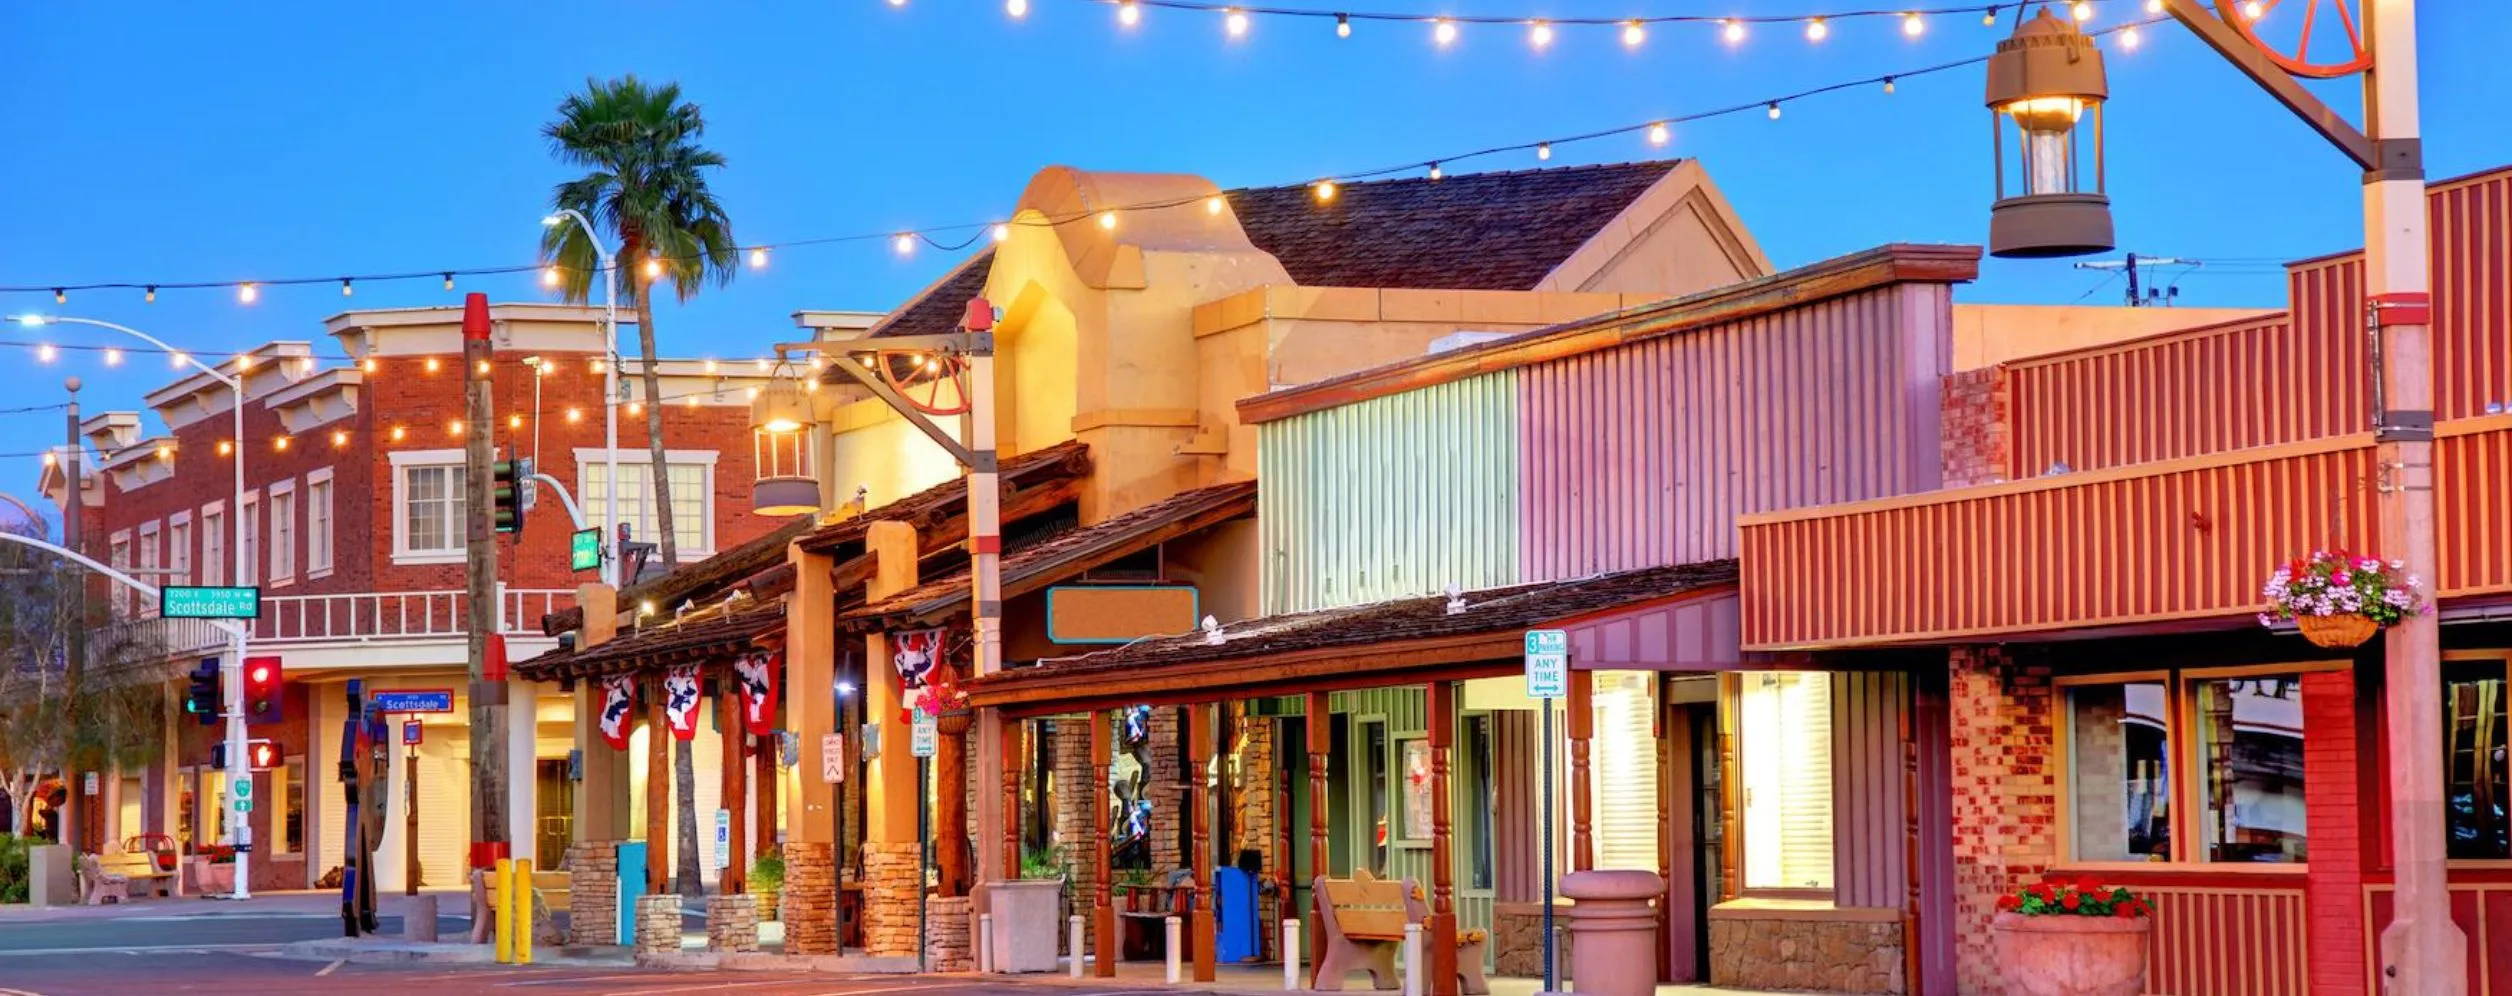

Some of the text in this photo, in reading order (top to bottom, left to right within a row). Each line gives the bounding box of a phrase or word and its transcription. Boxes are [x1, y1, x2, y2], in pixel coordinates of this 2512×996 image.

[170, 601, 252, 614] Scottsdale Rd
[1529, 636, 1537, 650] 3
[1536, 659, 1556, 667] ANY
[1535, 672, 1558, 681] TIME
[386, 700, 438, 709] Scottsdale
